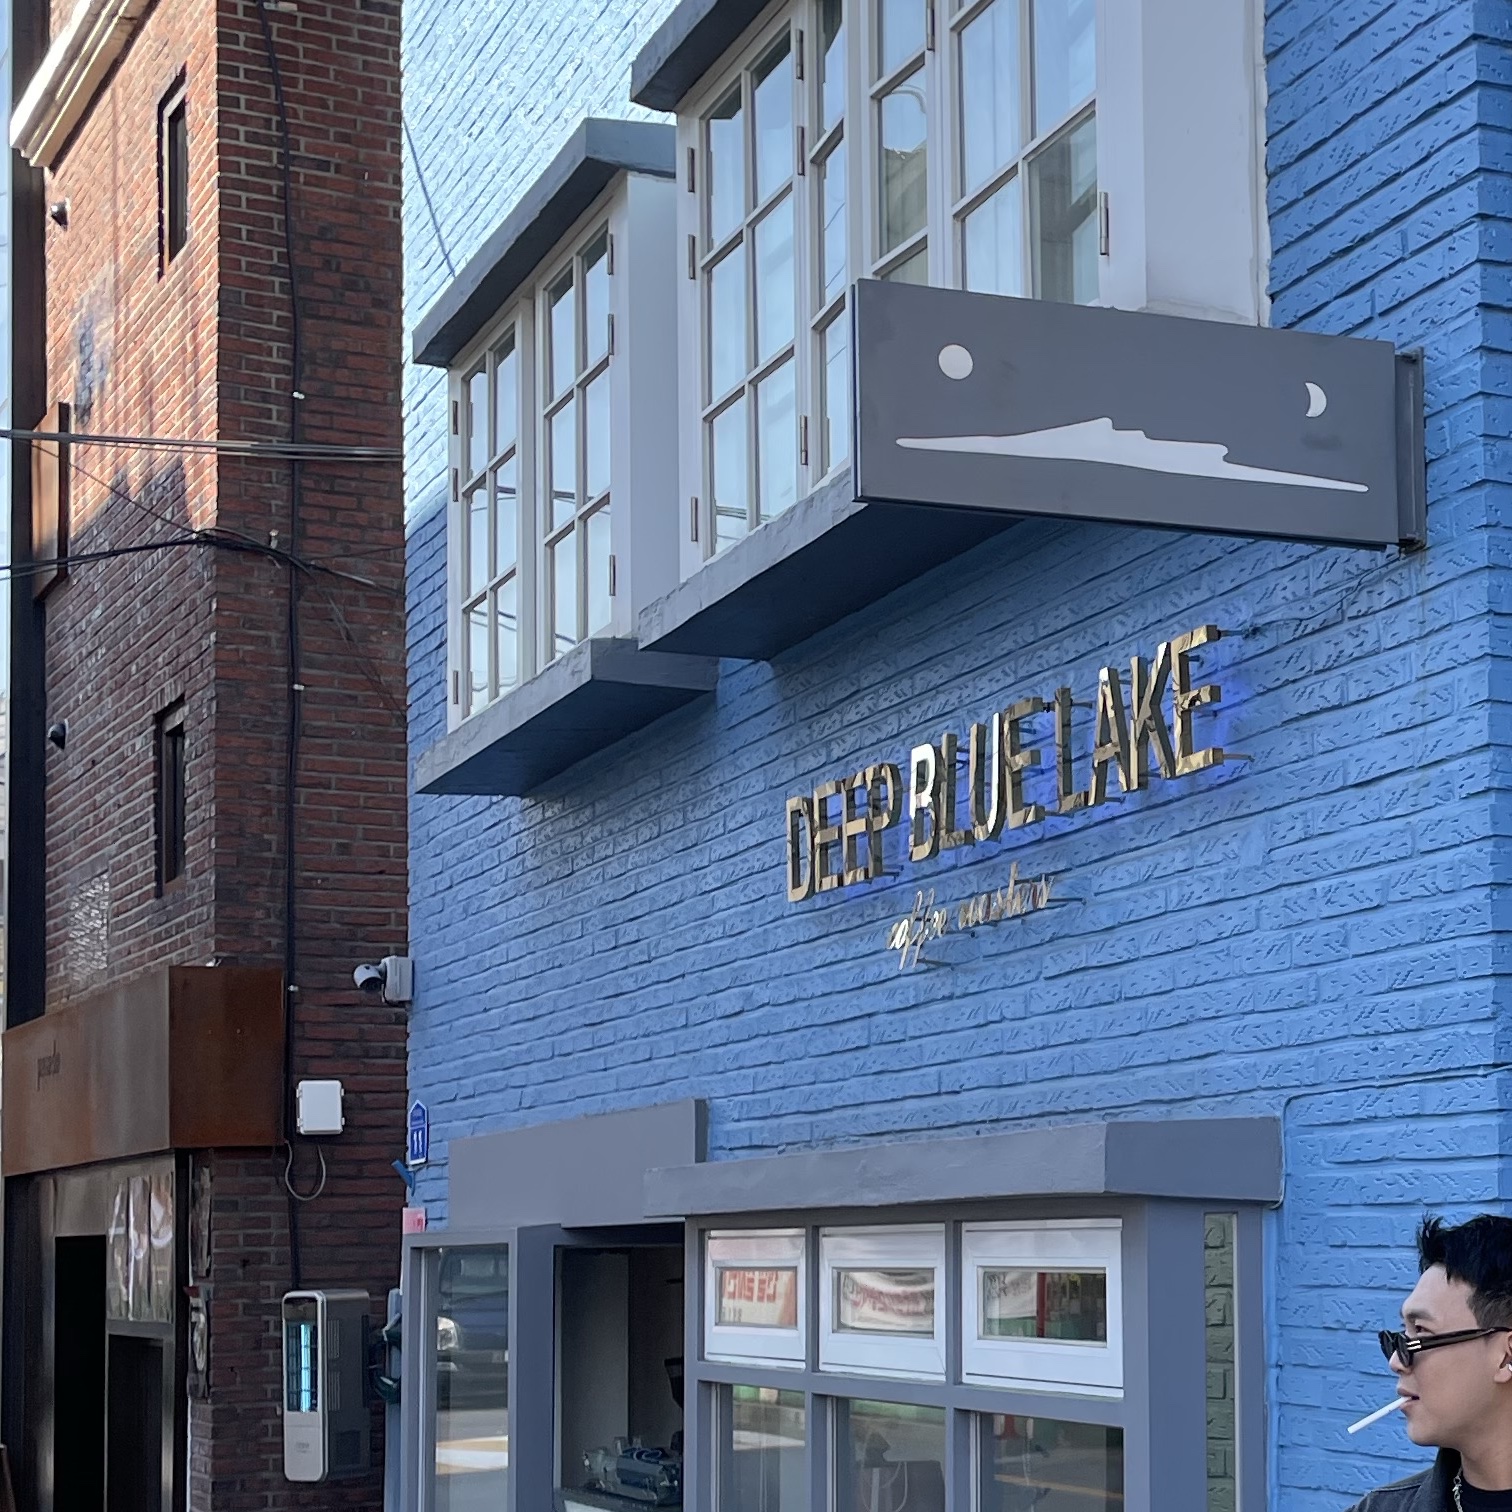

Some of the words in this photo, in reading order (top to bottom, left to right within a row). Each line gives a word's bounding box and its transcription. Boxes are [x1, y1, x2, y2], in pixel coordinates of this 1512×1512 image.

[786, 762, 901, 902] DEEP
[909, 697, 1044, 862] BLUE
[1056, 624, 1224, 814] LAKE
